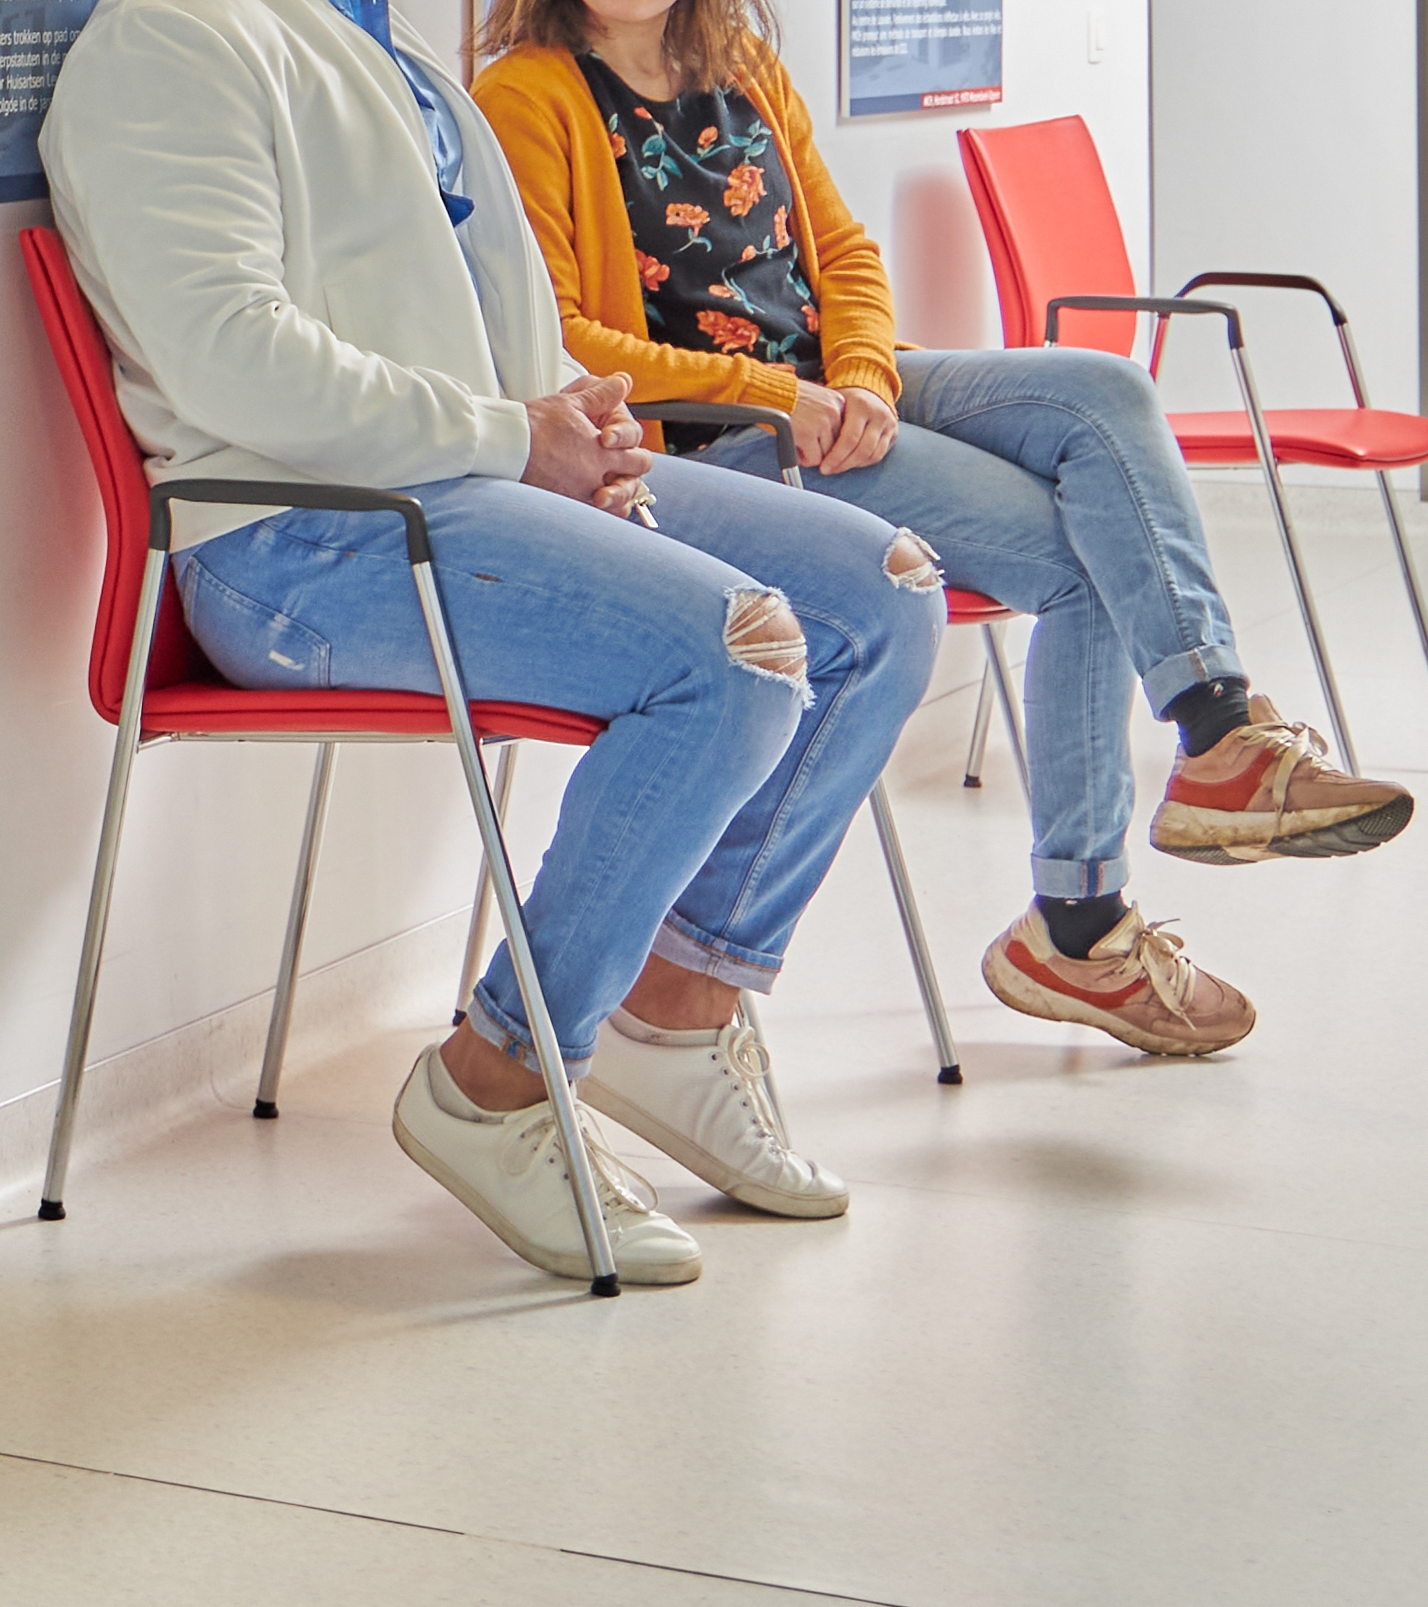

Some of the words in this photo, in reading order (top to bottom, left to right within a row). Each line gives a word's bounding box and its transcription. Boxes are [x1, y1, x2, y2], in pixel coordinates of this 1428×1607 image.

[13, 28, 41, 45] trokken
[42, 30, 52, 46] op
[54, 29, 67, 46] pad
[6, 73, 45, 89] Huisartsen
